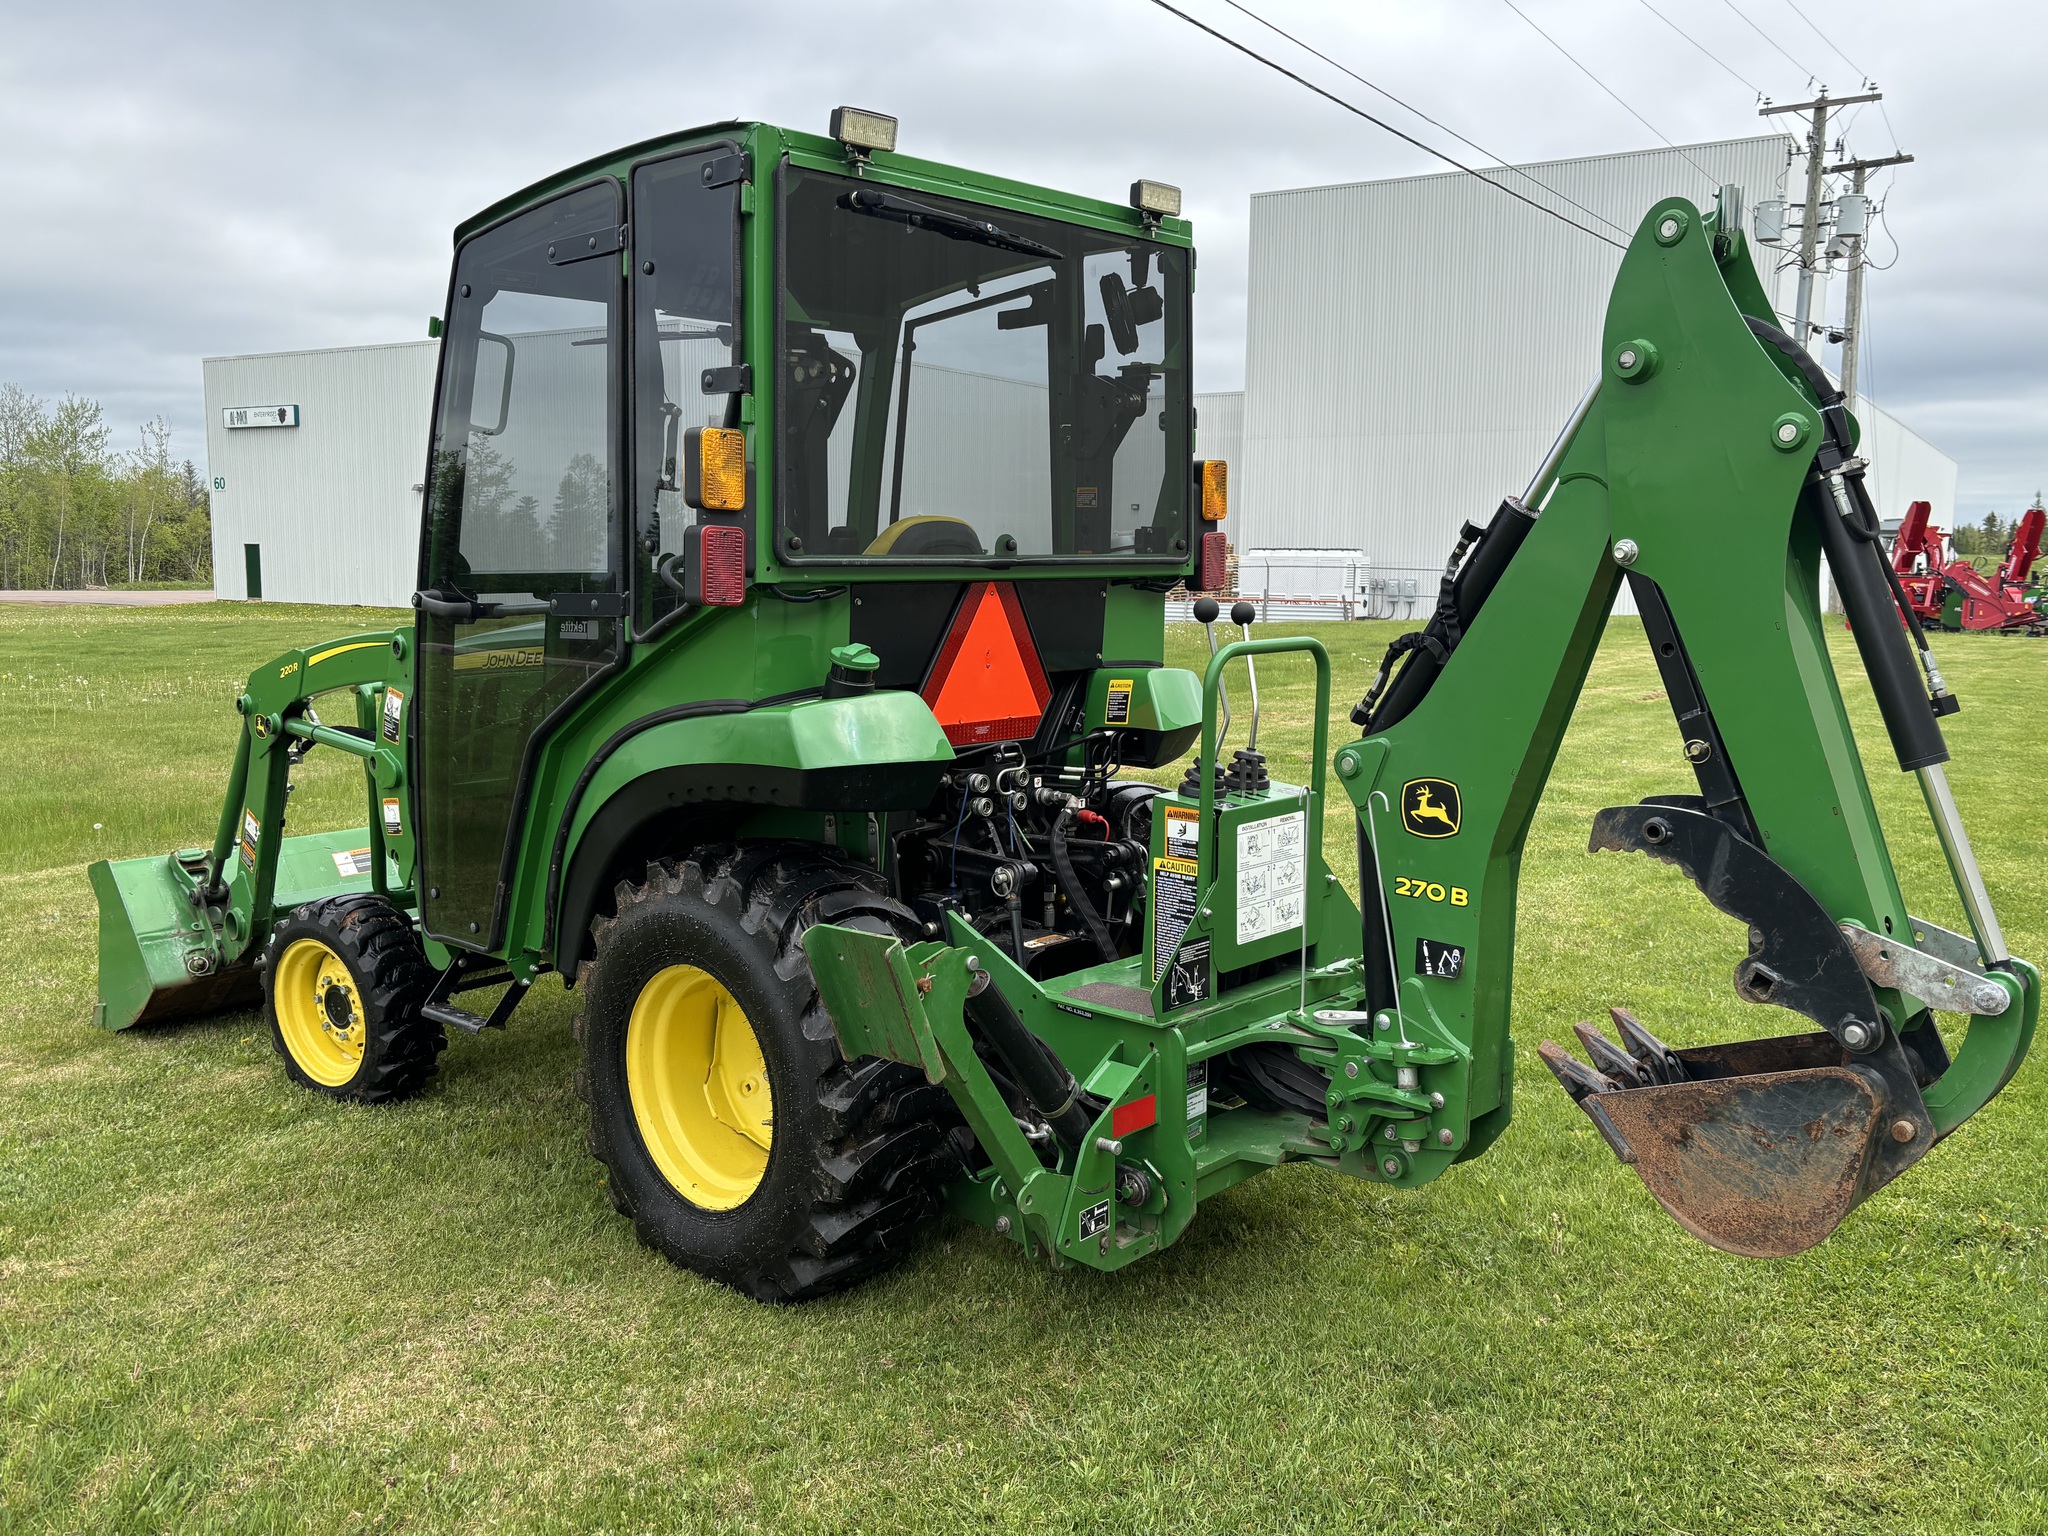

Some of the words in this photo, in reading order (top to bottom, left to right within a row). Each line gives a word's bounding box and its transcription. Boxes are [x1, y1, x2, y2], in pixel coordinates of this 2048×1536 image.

[214, 477, 225, 489] 60
[482, 653, 515, 668] JOHN
[515, 650, 544, 665] DEE
[1173, 810, 1199, 821] WARNING
[1280, 815, 1296, 823] REMOVAL
[1242, 822, 1267, 831] INSTALLATION
[1166, 861, 1197, 874] CAUTION
